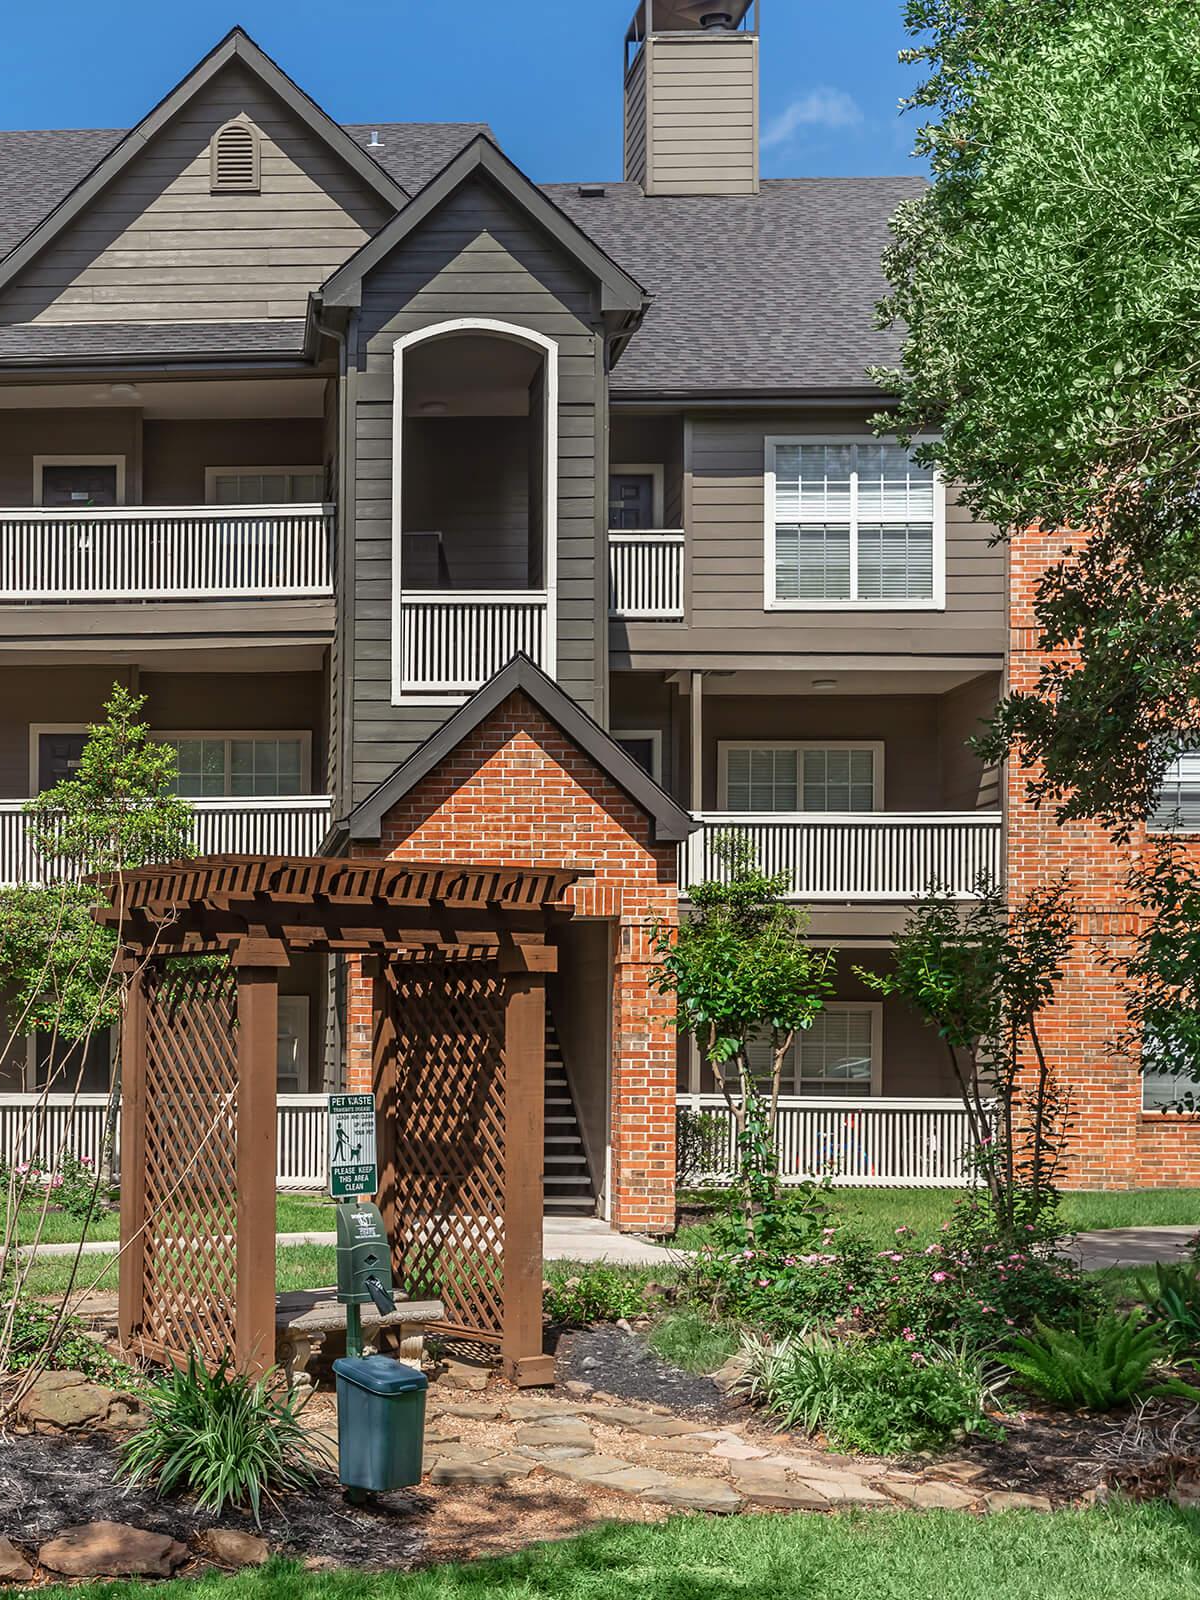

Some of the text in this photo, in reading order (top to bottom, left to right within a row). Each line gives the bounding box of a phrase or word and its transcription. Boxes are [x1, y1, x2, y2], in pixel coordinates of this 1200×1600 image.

[332, 1096, 372, 1106] PET WASTE
[334, 1167, 356, 1175] PLEASE
[339, 1174, 369, 1183] THIS AREA
[345, 1183, 364, 1191] CLEAN
